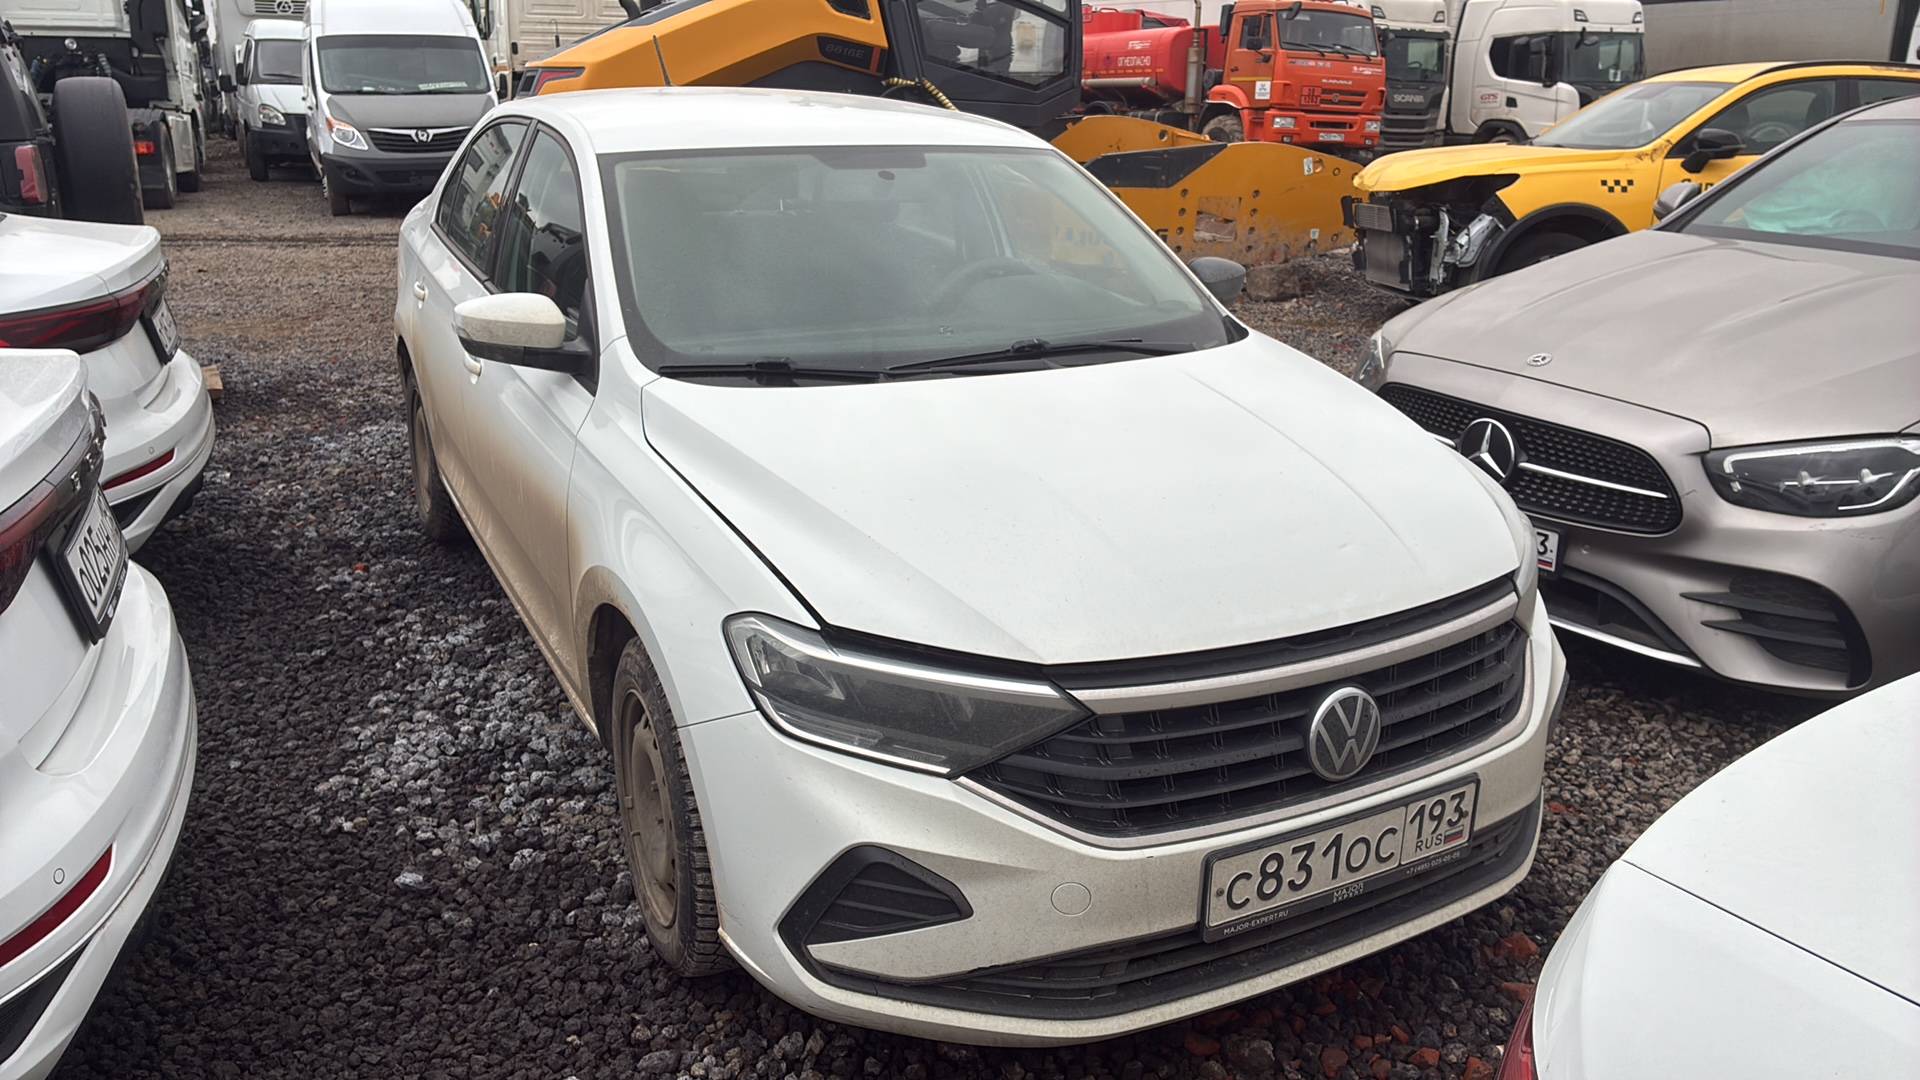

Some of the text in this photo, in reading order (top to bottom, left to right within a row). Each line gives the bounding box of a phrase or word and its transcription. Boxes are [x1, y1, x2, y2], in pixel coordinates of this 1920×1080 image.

[1393, 94, 1425, 103] SCANIA
[1226, 791, 1466, 910] C831OC 193
[1415, 833, 1443, 853] RUS
[1333, 882, 1364, 898] MAJOR
[1223, 910, 1289, 936] MAJOR-EXPERT.RU
